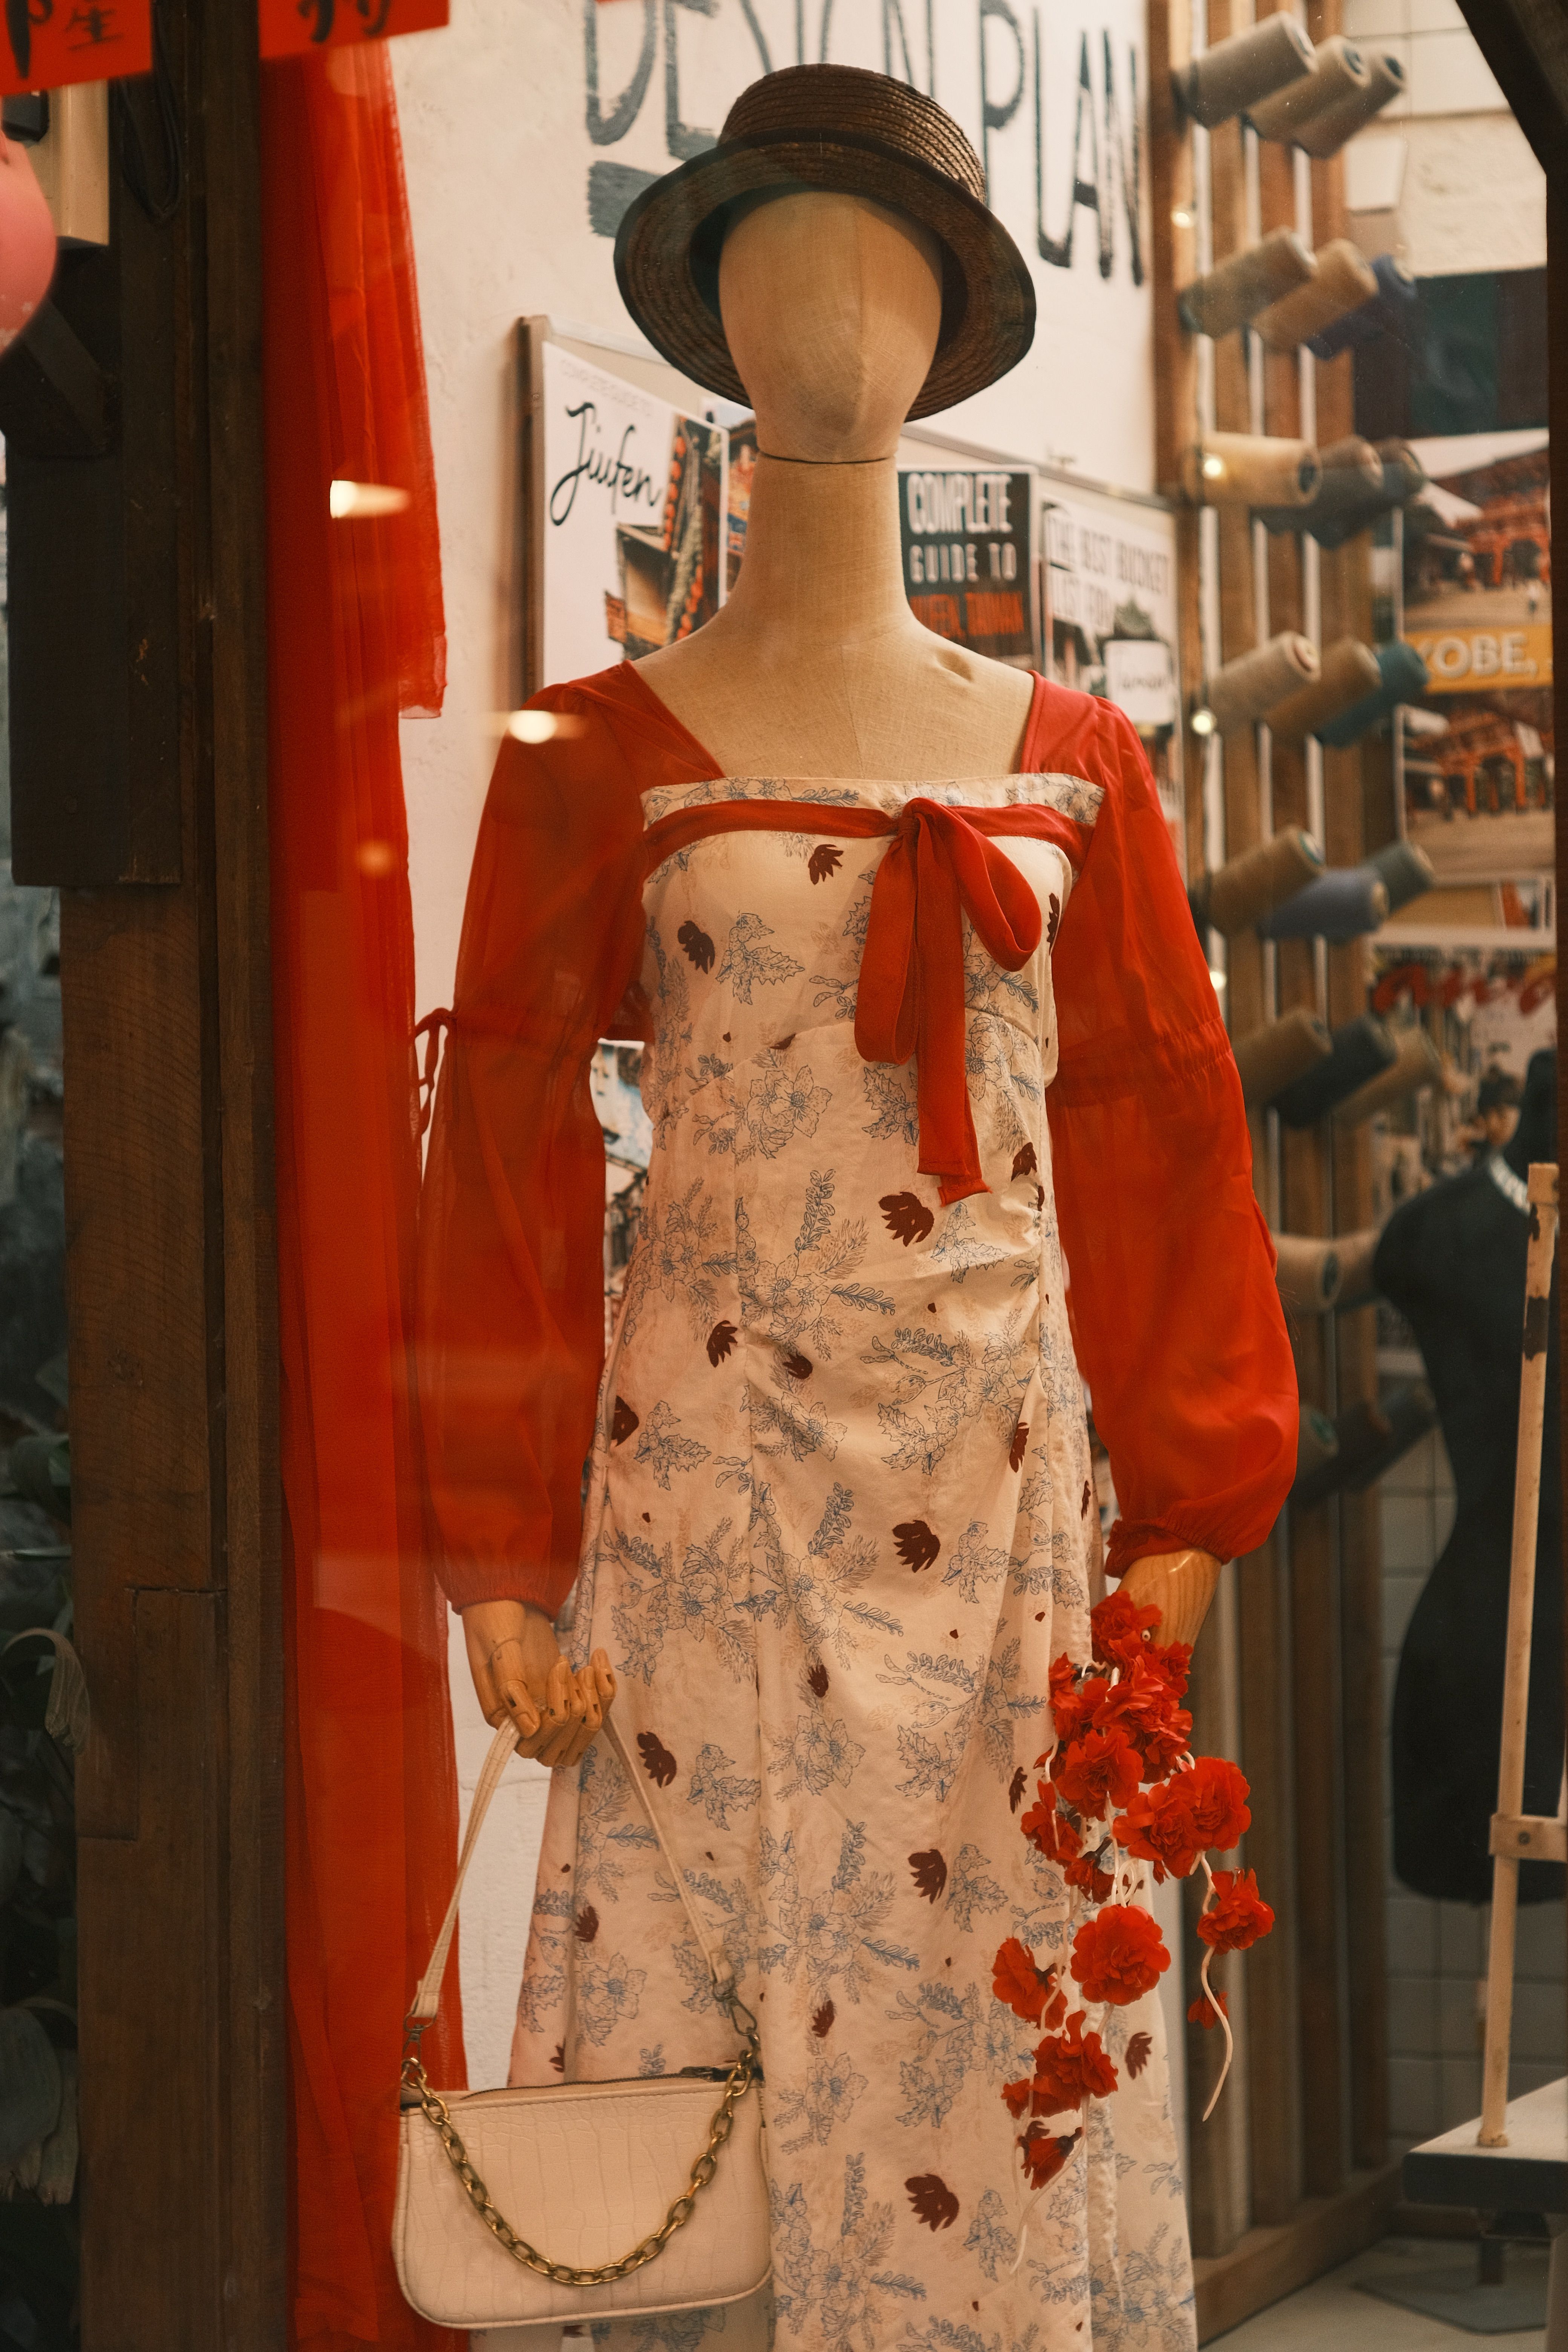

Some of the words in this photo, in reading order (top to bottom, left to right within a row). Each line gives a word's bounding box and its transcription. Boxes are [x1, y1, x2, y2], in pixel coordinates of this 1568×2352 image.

[979, 0, 1144, 286] PLAN
[550, 402, 662, 526] Jiufen
[908, 473, 1013, 534] COMPLETE
[910, 544, 978, 583] GUIDE
[988, 542, 1017, 581] TO
